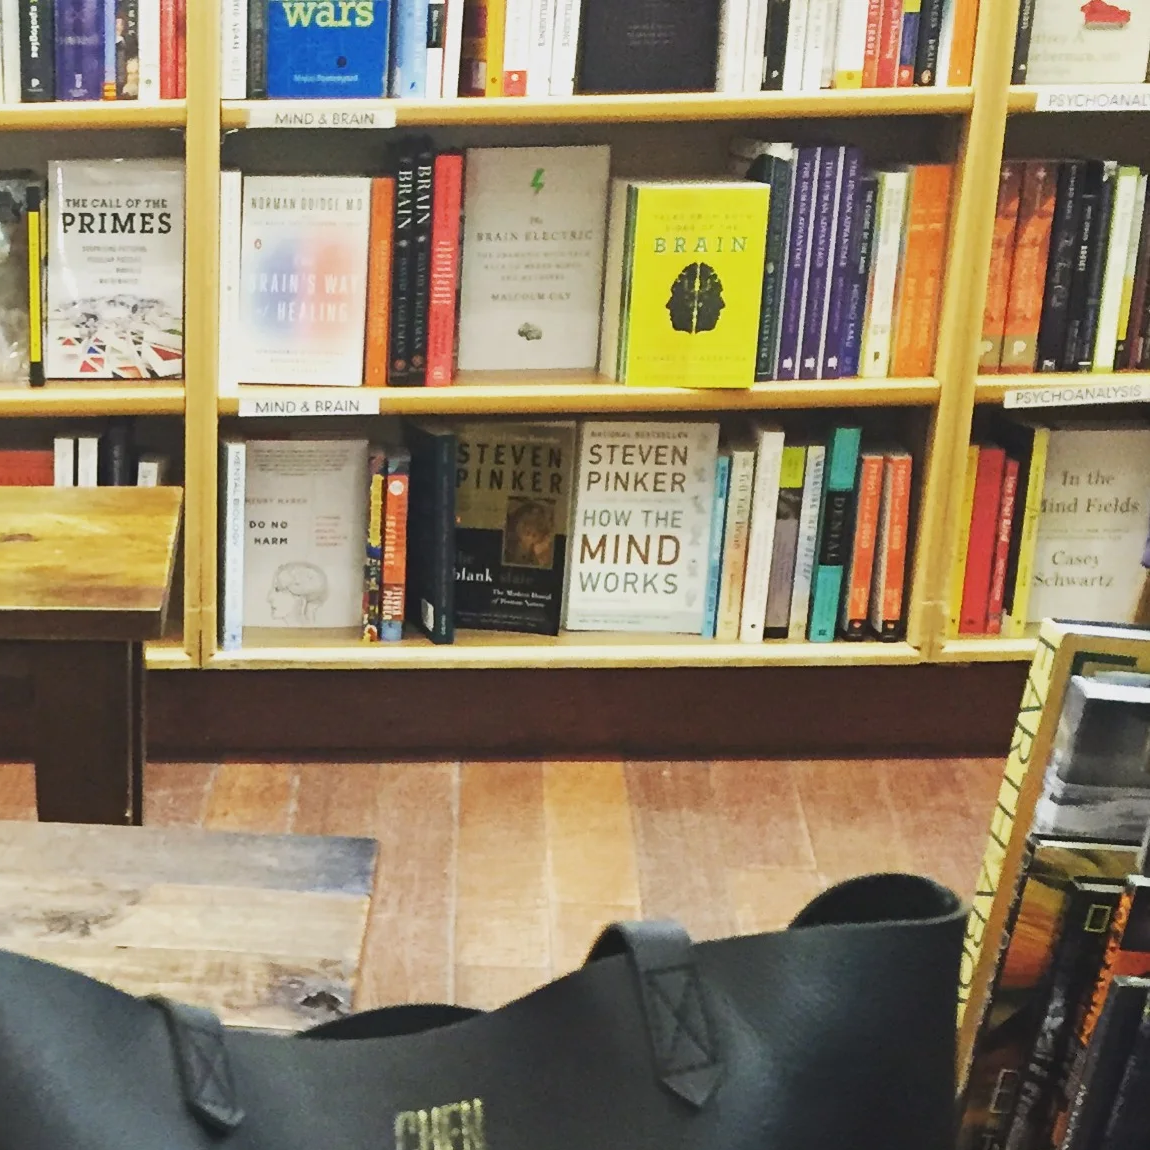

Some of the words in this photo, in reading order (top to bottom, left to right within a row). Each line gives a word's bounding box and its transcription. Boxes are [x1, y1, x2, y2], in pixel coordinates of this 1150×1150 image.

[282, 0, 374, 28] wars
[275, 113, 314, 125] MIND
[319, 113, 328, 125] &
[332, 112, 375, 125] BRAIN
[65, 198, 88, 209] THE
[90, 198, 122, 209] CALL
[126, 198, 141, 209] OF
[144, 198, 169, 209] THE
[251, 197, 296, 210] NORMAN
[397, 171, 413, 229] BRAIN
[416, 165, 432, 225] BRAIN
[62, 212, 172, 235] PRIMES
[476, 231, 519, 242] BRAIN
[524, 230, 593, 242] ELECTRIC
[653, 236, 749, 254] BRAIN
[277, 302, 349, 322] HEALING
[1016, 385, 1143, 404] PSYCHOANALYSIS
[255, 401, 296, 414] MIND
[300, 401, 310, 412] &
[315, 400, 360, 413] BRAIN
[457, 443, 563, 470] STEVEN
[588, 443, 689, 467] STEVEN
[233, 451, 241, 496] MENTAL
[454, 468, 564, 495] PINKER
[586, 471, 686, 493] PINKER
[1062, 471, 1080, 487] In
[1087, 469, 1115, 486] the
[1086, 498, 1140, 514] Fields
[232, 499, 240, 547] BIOLOGY
[250, 520, 265, 529] DO
[271, 520, 288, 529] NO
[583, 509, 632, 528] HOW
[641, 509, 684, 529] THE
[826, 497, 846, 558] DENIAL
[254, 537, 288, 546] HARM
[579, 533, 681, 566] MIND
[1052, 550, 1099, 568] Casey
[453, 567, 493, 583] blank
[579, 571, 679, 595] WORKS
[1032, 574, 1114, 588] Schwartz
